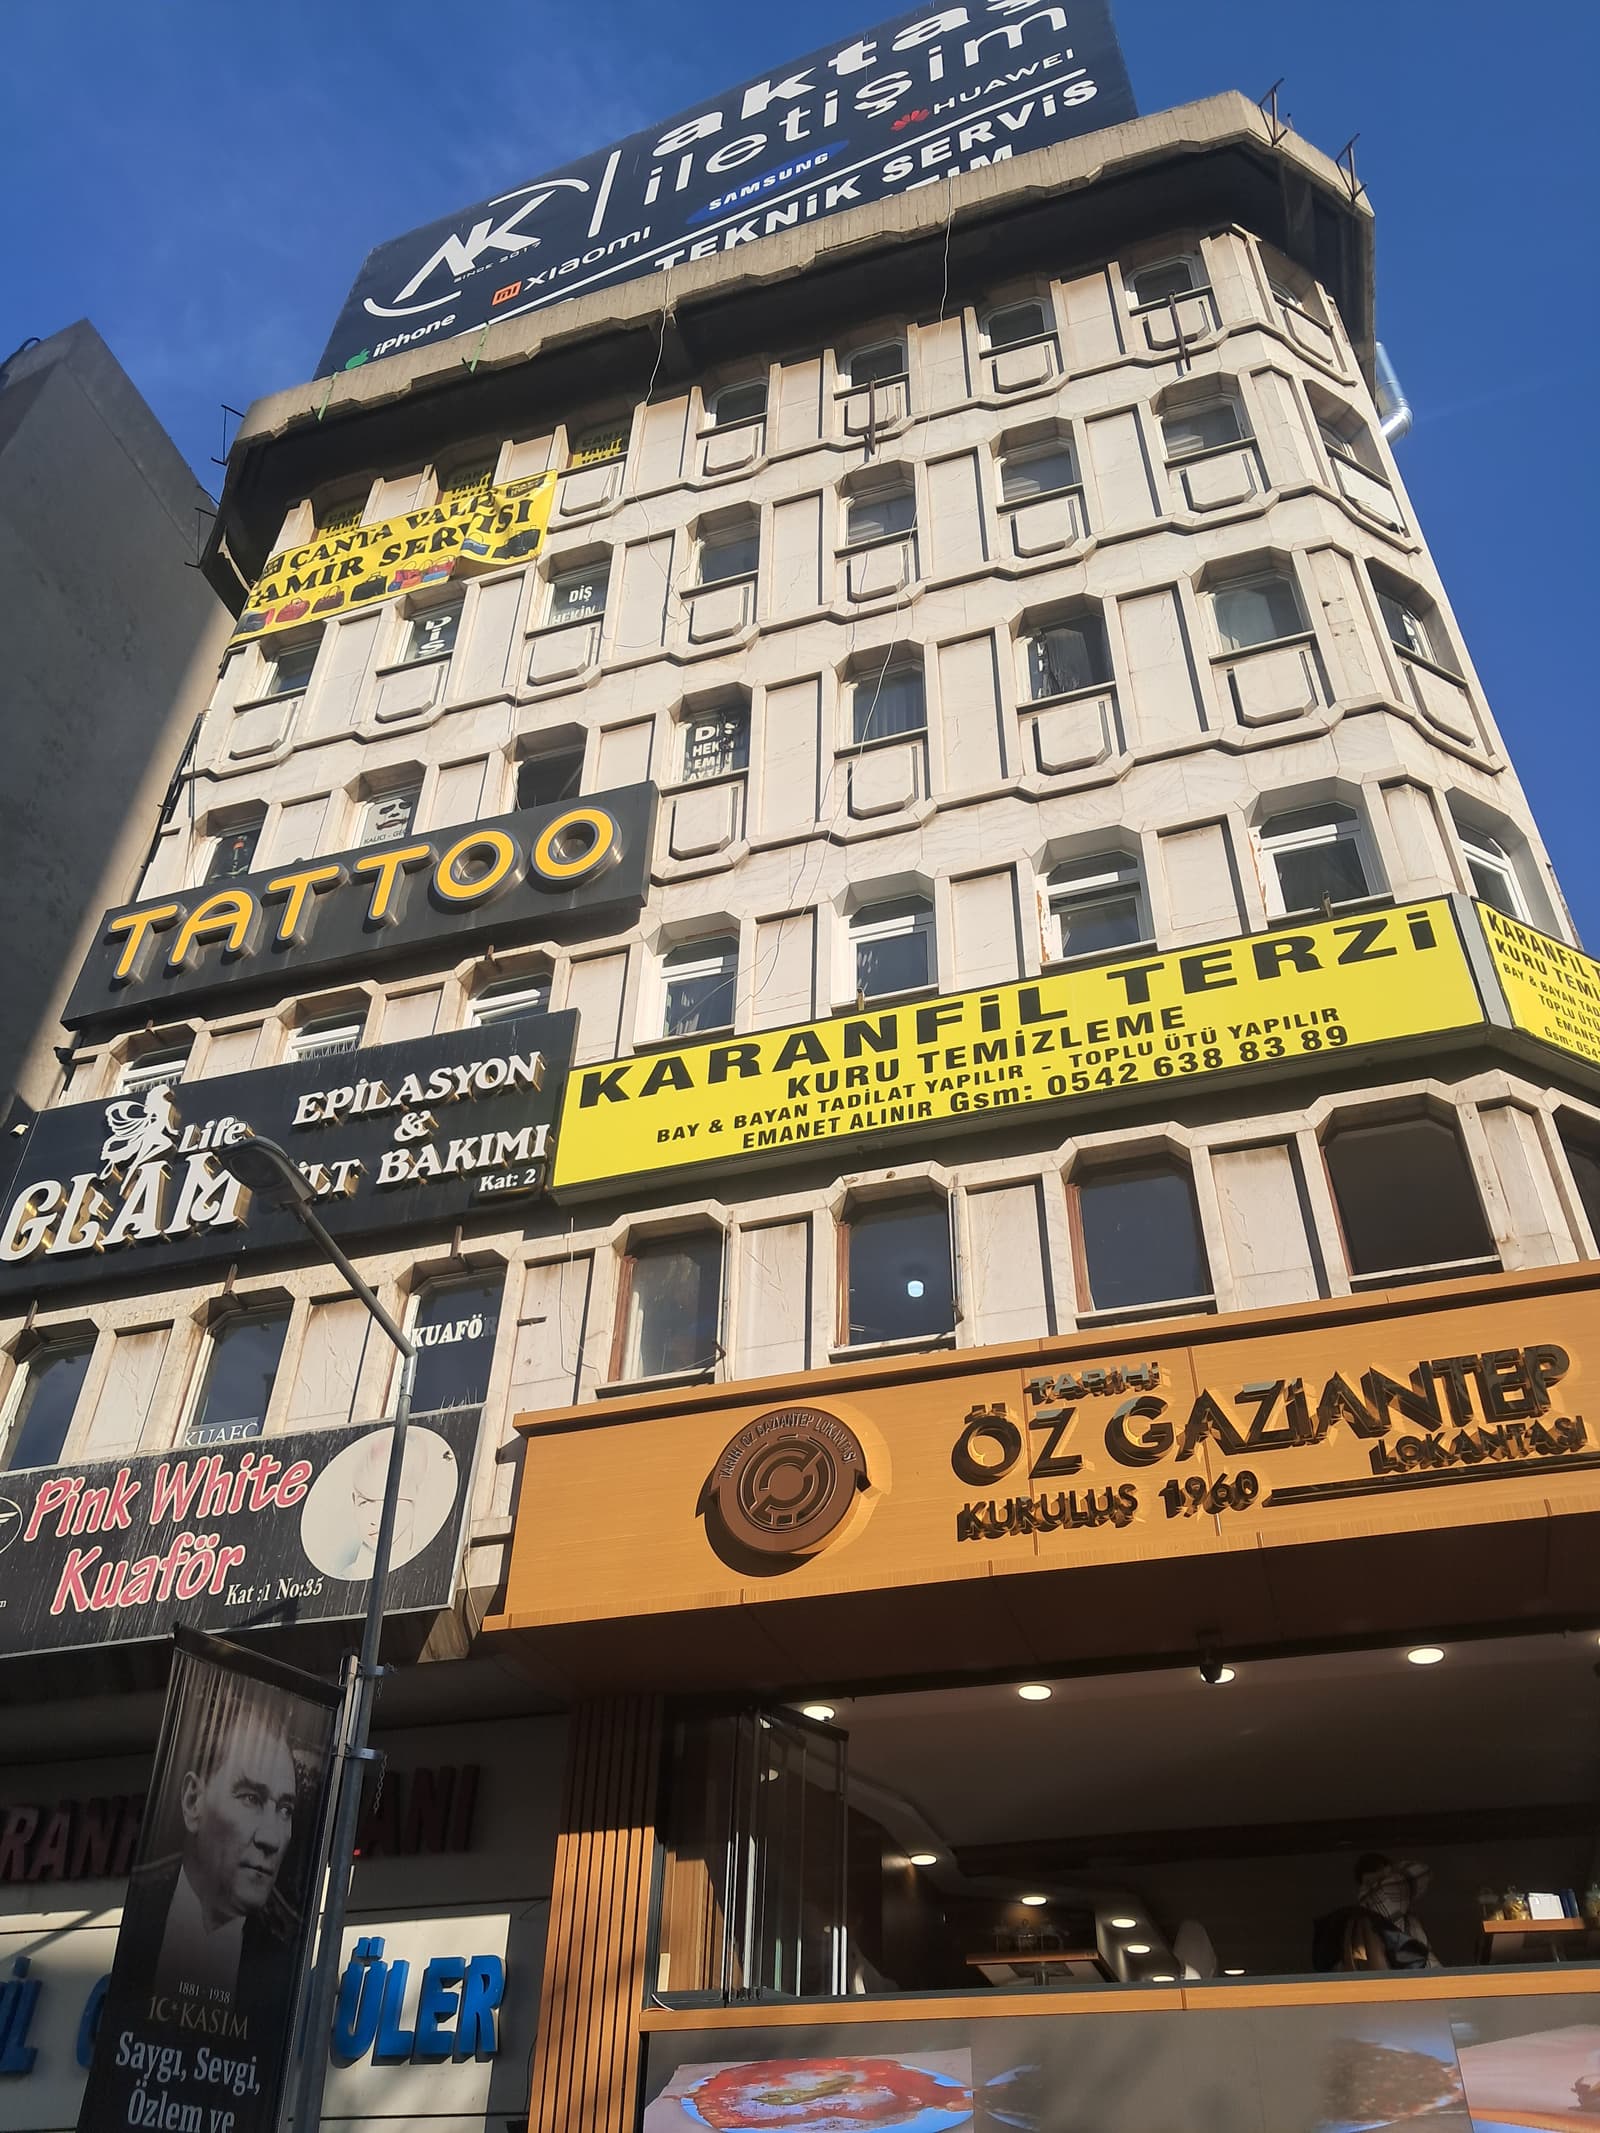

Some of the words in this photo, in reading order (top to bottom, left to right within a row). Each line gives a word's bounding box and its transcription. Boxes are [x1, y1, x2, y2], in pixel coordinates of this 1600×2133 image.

[643, 7, 1067, 206] iletişim
[934, 48, 1074, 115] HUAWEI
[708, 152, 830, 211] SAMSUNG
[373, 313, 456, 357] iPhone
[109, 807, 619, 983] TATTOO
[1494, 939, 1548, 977] KURU
[1503, 962, 1525, 981] BAY
[1540, 980, 1577, 1006] BAYAN
[1579, 999, 1600, 1019] TAD
[1538, 993, 1576, 1020] TOPLU
[657, 1123, 700, 1143] BAY
[708, 1119, 724, 1134] &
[734, 1103, 808, 1129] BAYAN
[924, 1063, 1024, 1091] YAPILIR
[1069, 1041, 1153, 1069] TOPLU
[1164, 1025, 1217, 1051] ÜTÜ
[1227, 1006, 1340, 1040] YAPILIR
[1576, 1040, 1600, 1058] 054
[743, 1117, 839, 1150] EMANET
[849, 1101, 932, 1131] ALINIR
[950, 1082, 1033, 1115] Gsm:
[1047, 1063, 1138, 1097] 0542
[1153, 1049, 1223, 1079] 638
[1240, 1035, 1285, 1063] 83
[1302, 1024, 1348, 1052] 89
[787, 1058, 899, 1100] KURU
[177, 1116, 248, 1155] Life
[377, 1124, 551, 1186] BAKIMI
[393, 1110, 431, 1143] &
[522, 1168, 537, 1185] 2
[411, 1313, 486, 1348] KUAFÖ
[951, 1403, 1084, 1486] ÖZ
[1159, 1470, 1259, 1518] 1960
[1370, 1415, 1587, 1475] LOKANTASI
[23, 1467, 145, 1543] Pink
[148, 1453, 313, 1526] White
[49, 1531, 247, 1617] Kuaför
[178, 1980, 200, 1998] 1881
[208, 1987, 231, 2004] 1938
[179, 2001, 249, 2041] KASIM
[115, 2030, 187, 2082] Saygı,
[193, 2047, 261, 2097] Sevgi,
[127, 2079, 202, 2133] Özlem
[209, 2105, 236, 2133] ve
